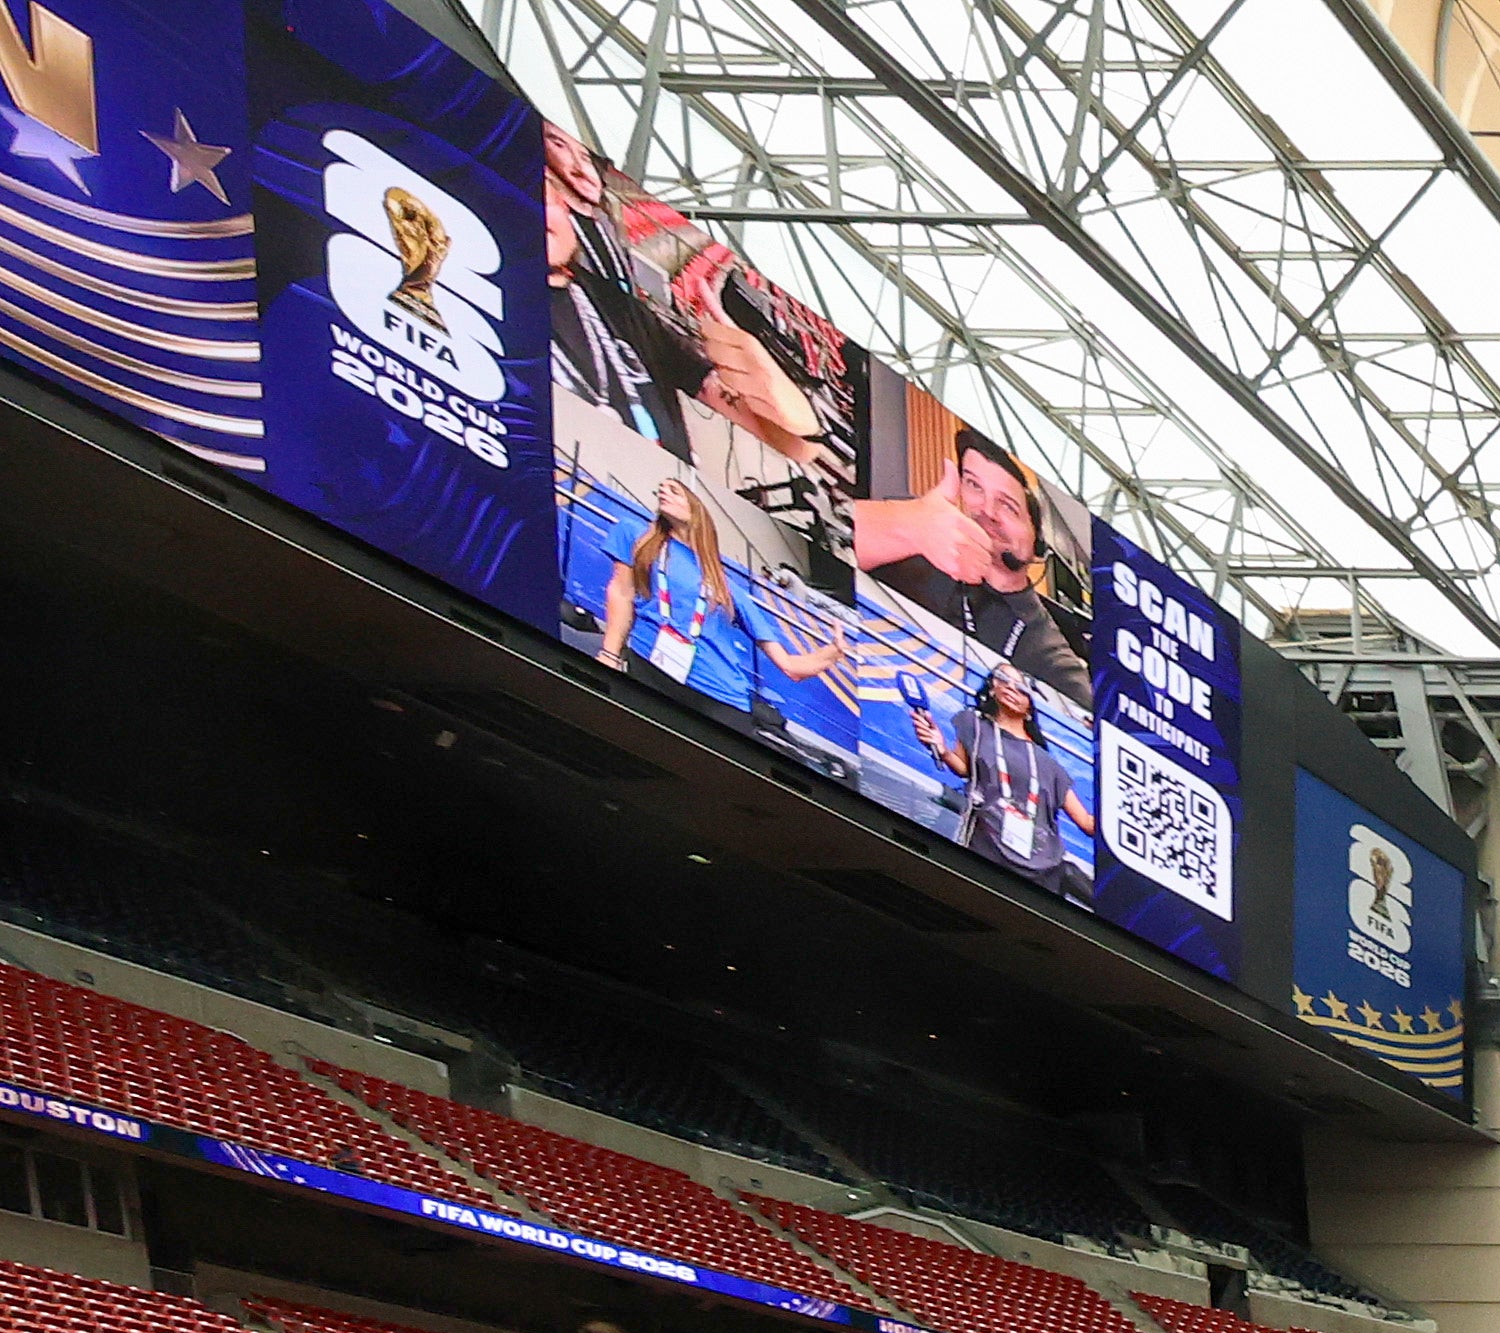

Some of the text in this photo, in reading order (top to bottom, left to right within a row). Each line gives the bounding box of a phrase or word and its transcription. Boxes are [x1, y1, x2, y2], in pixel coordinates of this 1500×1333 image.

[383, 309, 460, 372] FIFA
[330, 323, 507, 436] WORLD CUP
[331, 350, 510, 469] 2026
[1112, 561, 1214, 662] SCAN
[1150, 626, 1179, 661] THE
[1116, 628, 1212, 721] CODE
[1154, 692, 1174, 720] TO
[1118, 693, 1210, 767] PARTICIPATE
[1367, 916, 1395, 939] FIFA
[1348, 942, 1411, 988] 2026
[422, 1198, 698, 1281] FIFA WORLD CUP 2026
